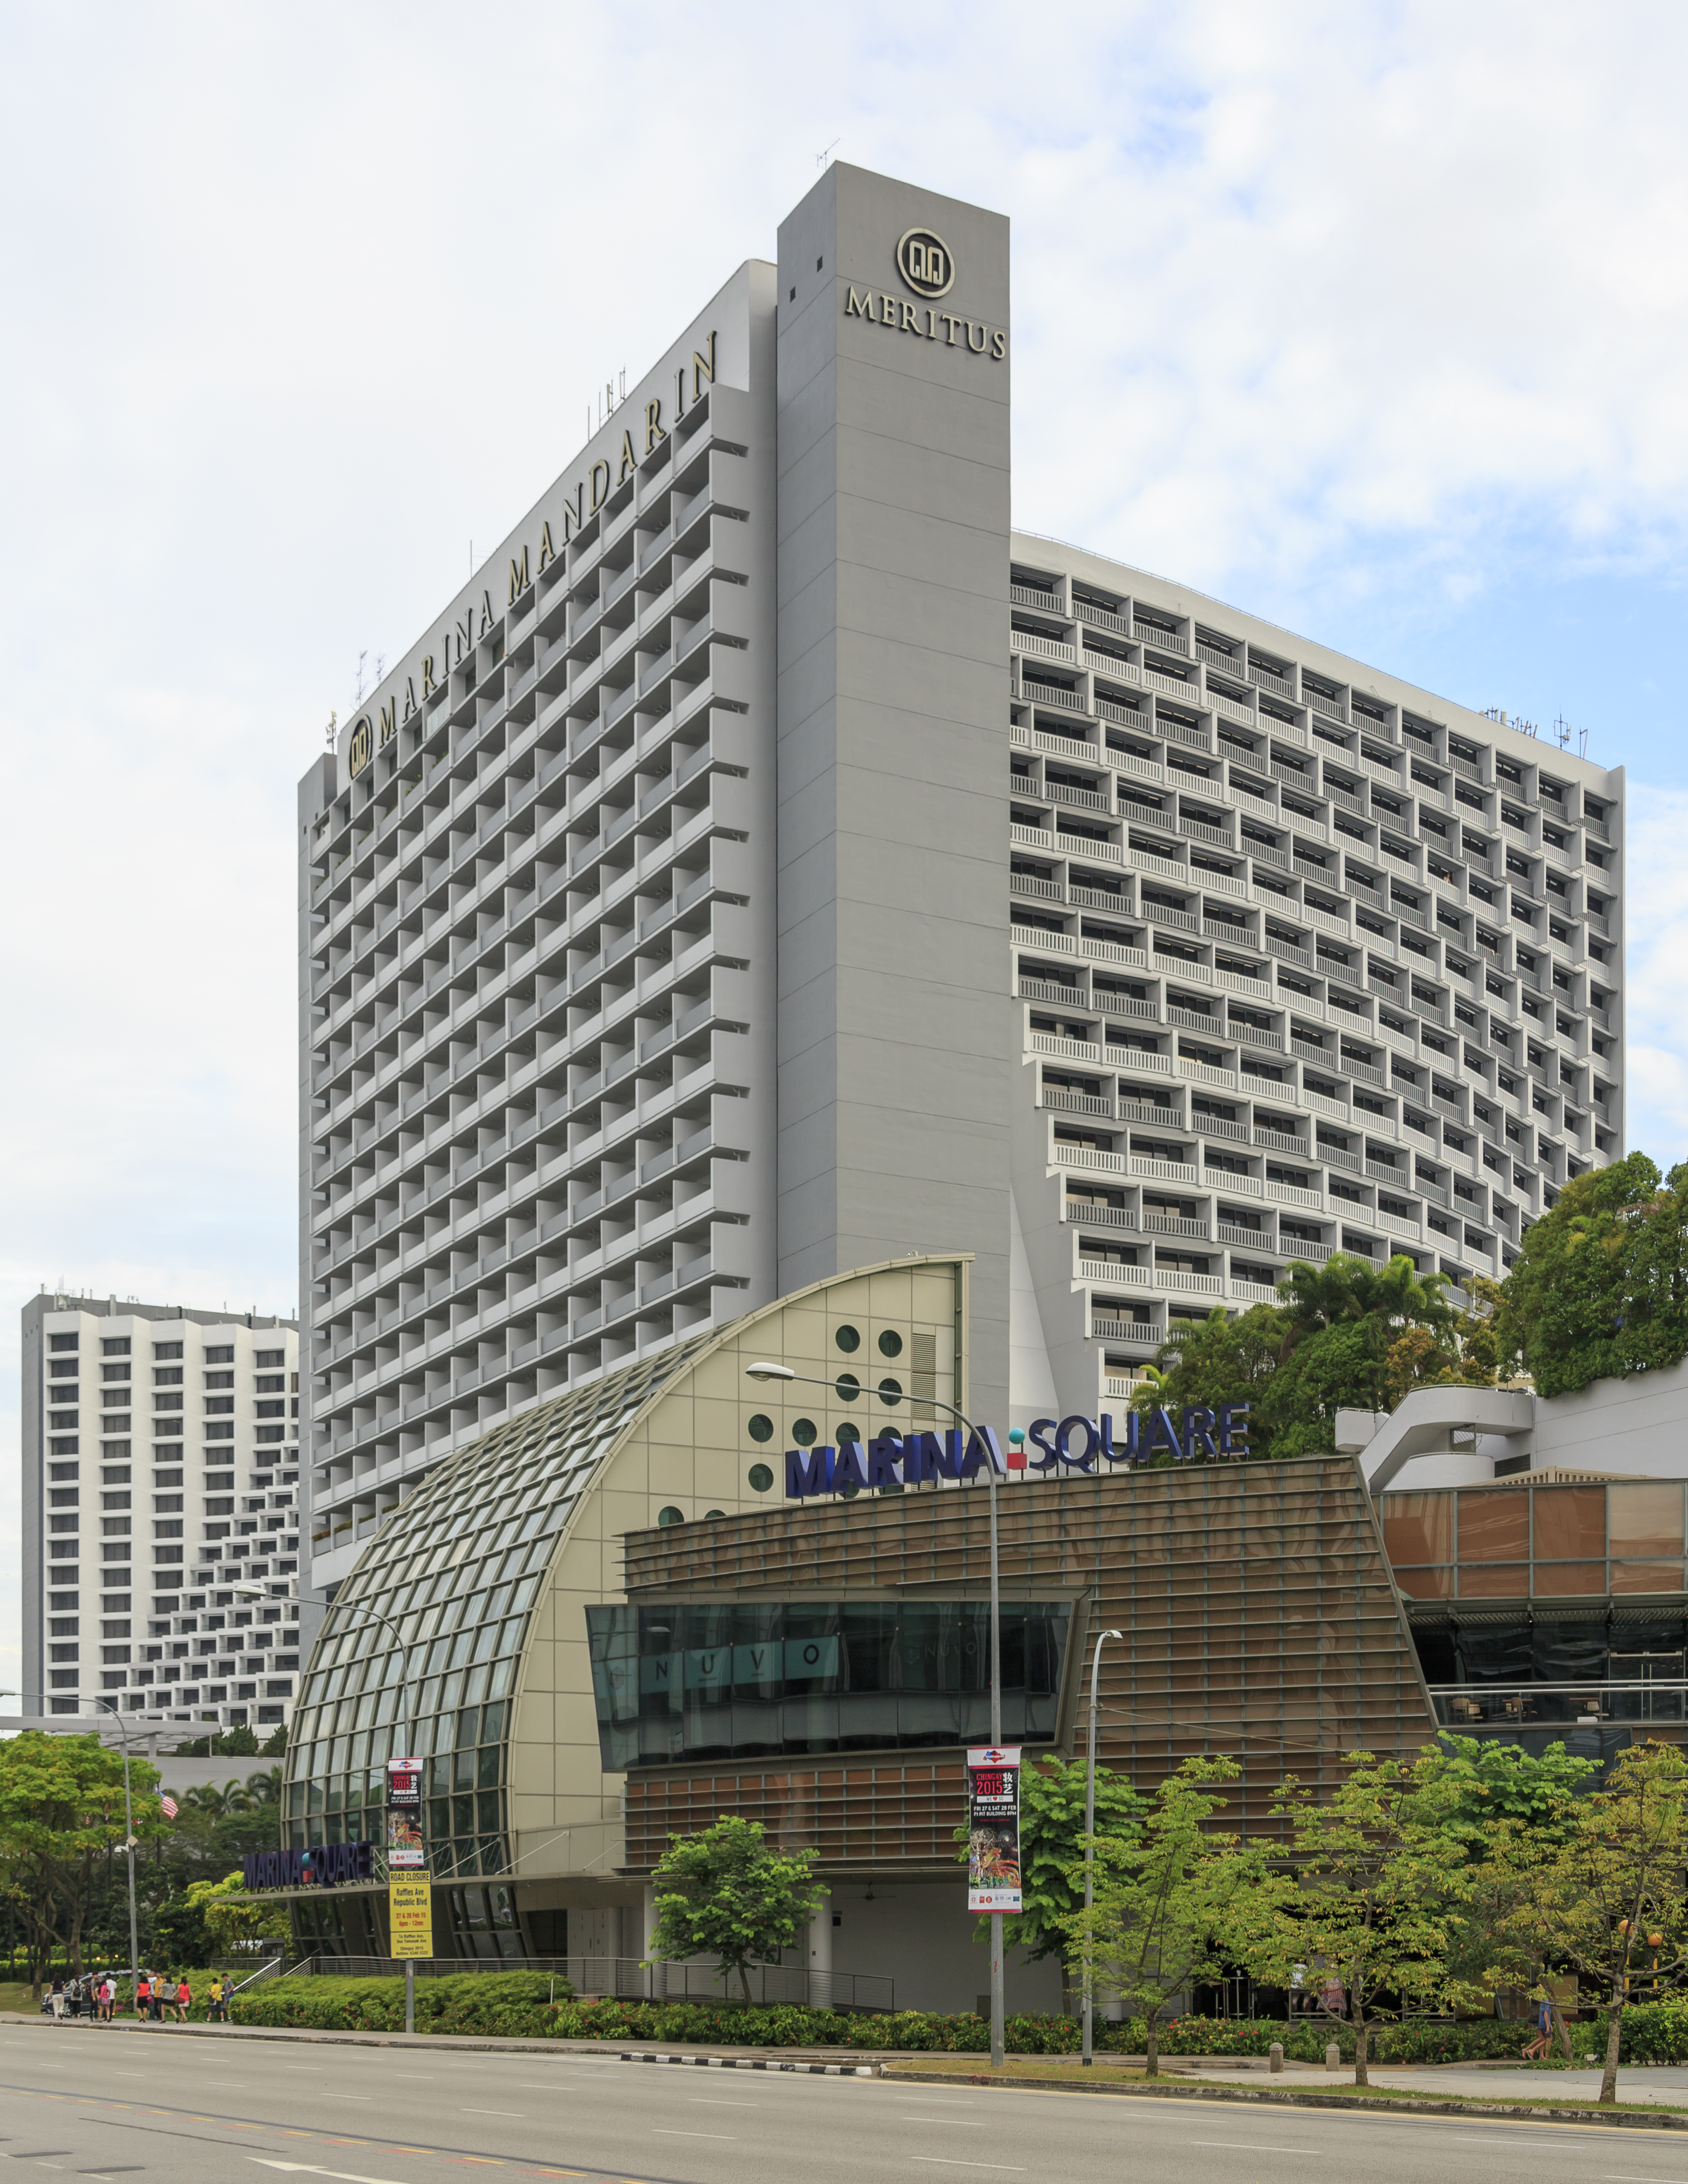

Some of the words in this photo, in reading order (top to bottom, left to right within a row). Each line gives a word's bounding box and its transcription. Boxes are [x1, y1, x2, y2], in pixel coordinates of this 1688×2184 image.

[846, 286, 1006, 359] MERITUS
[378, 589, 494, 749] MARINA
[507, 330, 717, 606] MANDARIN
[785, 1425, 1007, 1499] MARINA
[1029, 1402, 1249, 1474] SQUARE
[655, 1644, 819, 1681] NUVO
[393, 1780, 410, 1789] 2015
[977, 1781, 1002, 1795] 2015
[243, 1849, 302, 1888] MARINA
[308, 1841, 374, 1887] SQUARE
[391, 1873, 405, 1881] ROAD
[406, 1872, 429, 1881] CLOSURE
[393, 1898, 415, 1907] Republic
